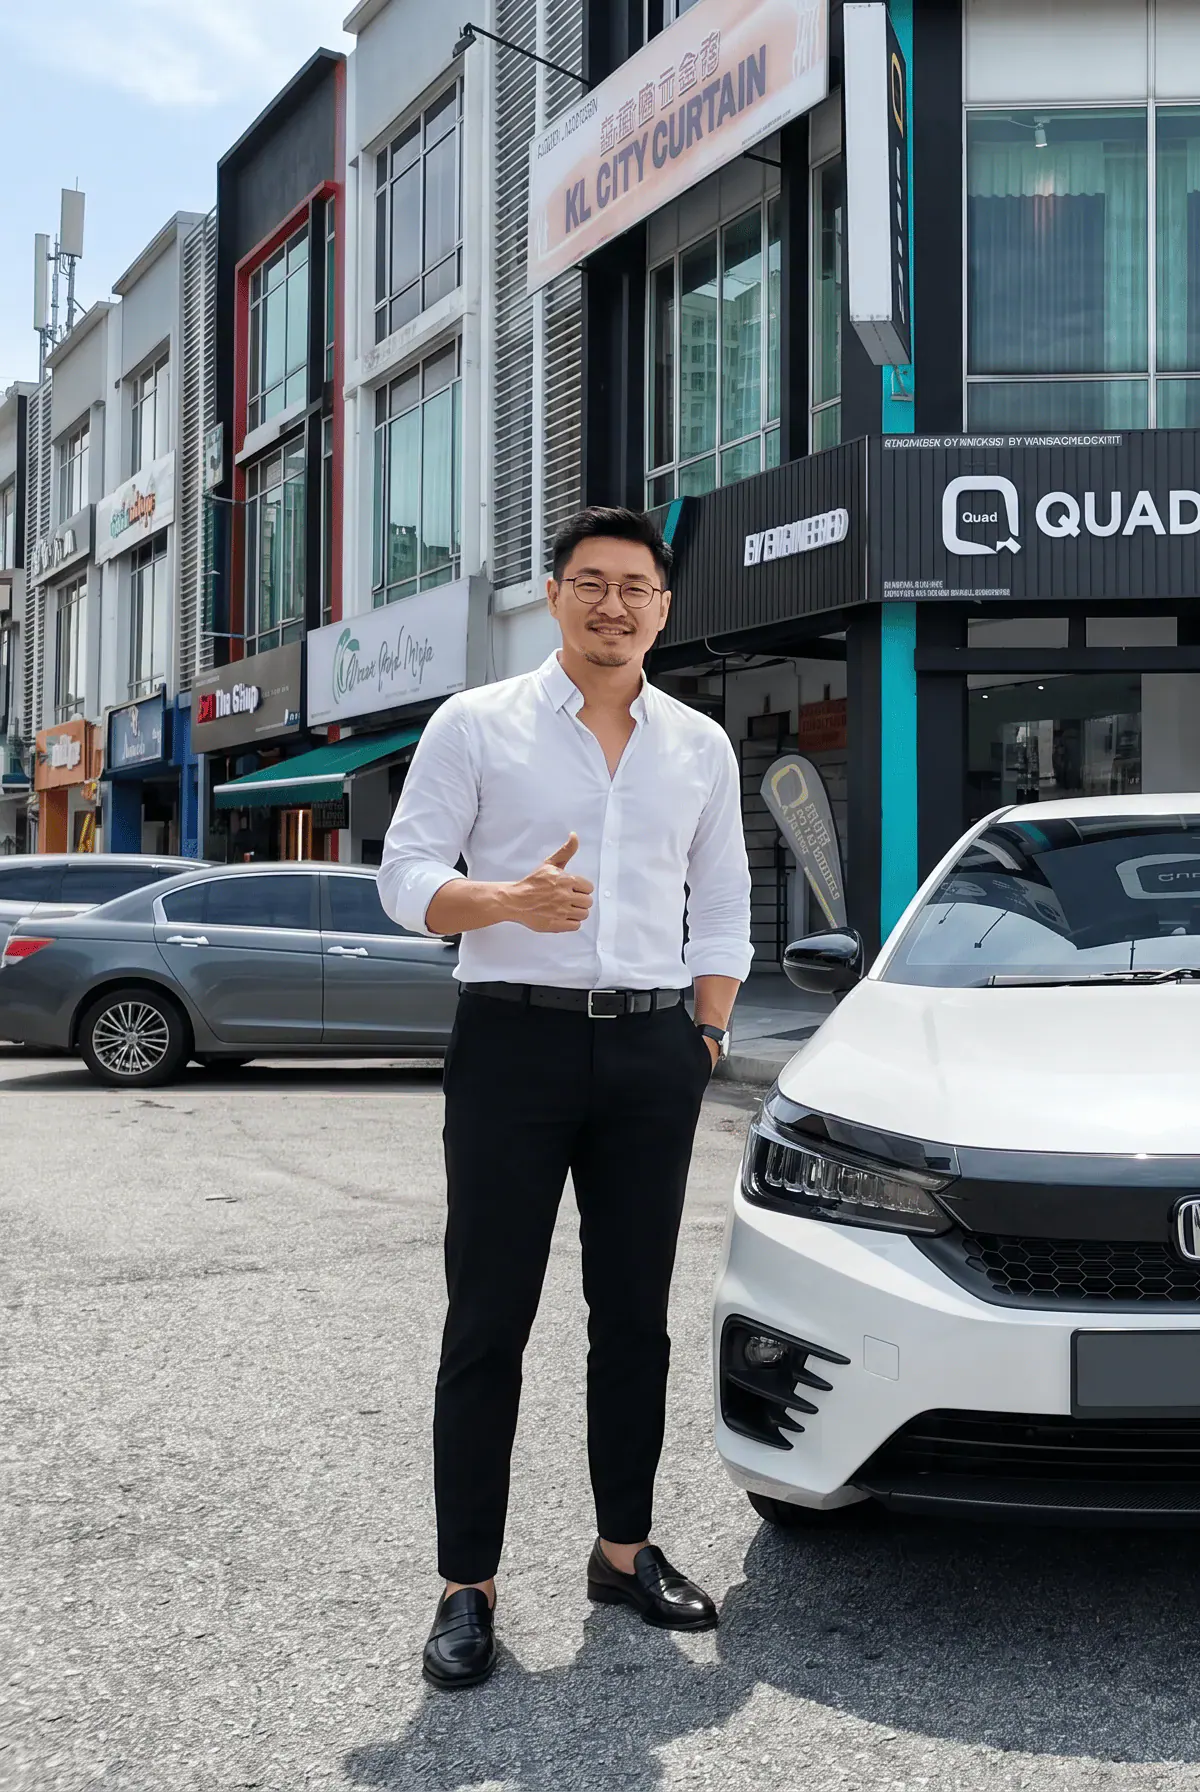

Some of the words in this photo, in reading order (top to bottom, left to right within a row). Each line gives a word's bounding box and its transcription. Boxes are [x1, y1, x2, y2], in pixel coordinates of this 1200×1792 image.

[565, 178, 592, 234] KL
[596, 131, 649, 209] CITY
[652, 43, 767, 169] CURTAIN
[962, 511, 998, 523] Quad
